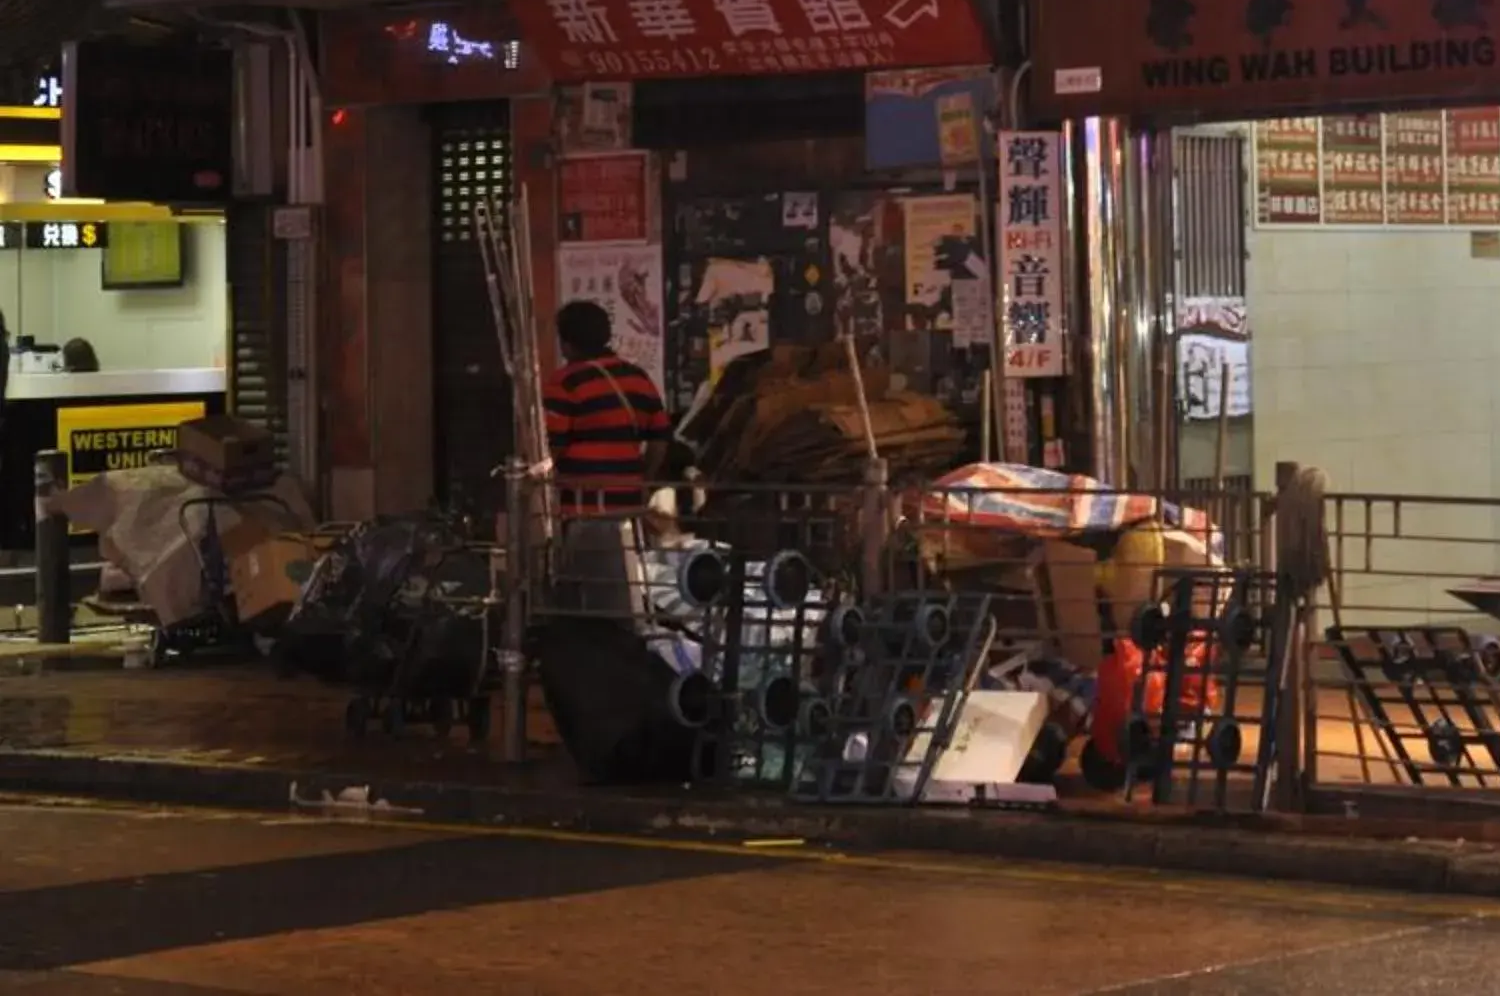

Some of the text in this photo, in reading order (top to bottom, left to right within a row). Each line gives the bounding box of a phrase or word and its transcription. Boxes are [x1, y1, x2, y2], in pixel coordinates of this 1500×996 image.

[1141, 56, 1230, 89] WING
[1240, 48, 1316, 83] WAH
[1328, 36, 1496, 76] BUILDING
[73, 428, 173, 451] WESTERN
[106, 449, 151, 470] UNI
